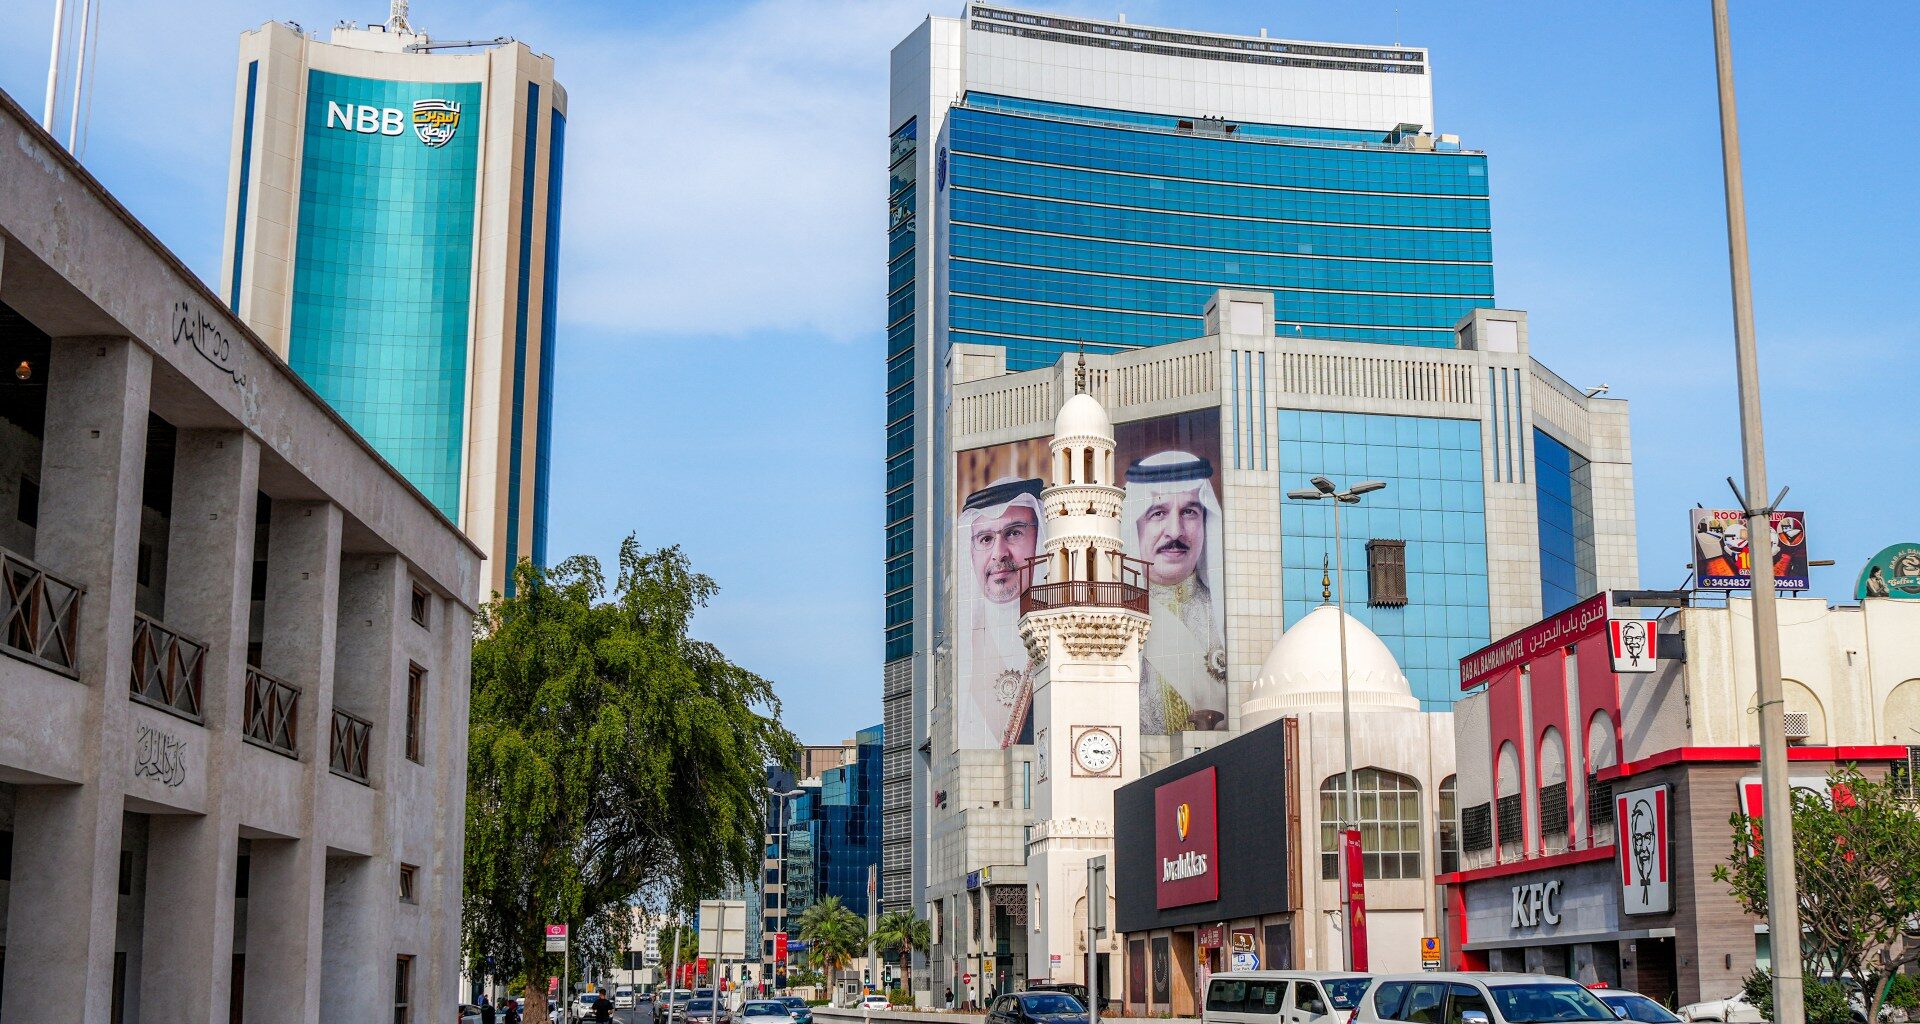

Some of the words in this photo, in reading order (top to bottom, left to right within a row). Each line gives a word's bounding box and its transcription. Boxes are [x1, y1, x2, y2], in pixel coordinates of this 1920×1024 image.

[327, 101, 404, 135] NBB
[1712, 579, 1750, 587] 3454837
[1562, 613, 1578, 637] باب
[1579, 602, 1604, 631] فندق
[1529, 619, 1561, 653] البحرين
[1461, 661, 1473, 683] BAB
[1473, 658, 1481, 677] AL
[1480, 645, 1505, 674] BAHRAIN
[1505, 637, 1525, 662] HOTEL
[1163, 851, 1208, 882] Joyalukkas
[1511, 880, 1561, 928] KFC
